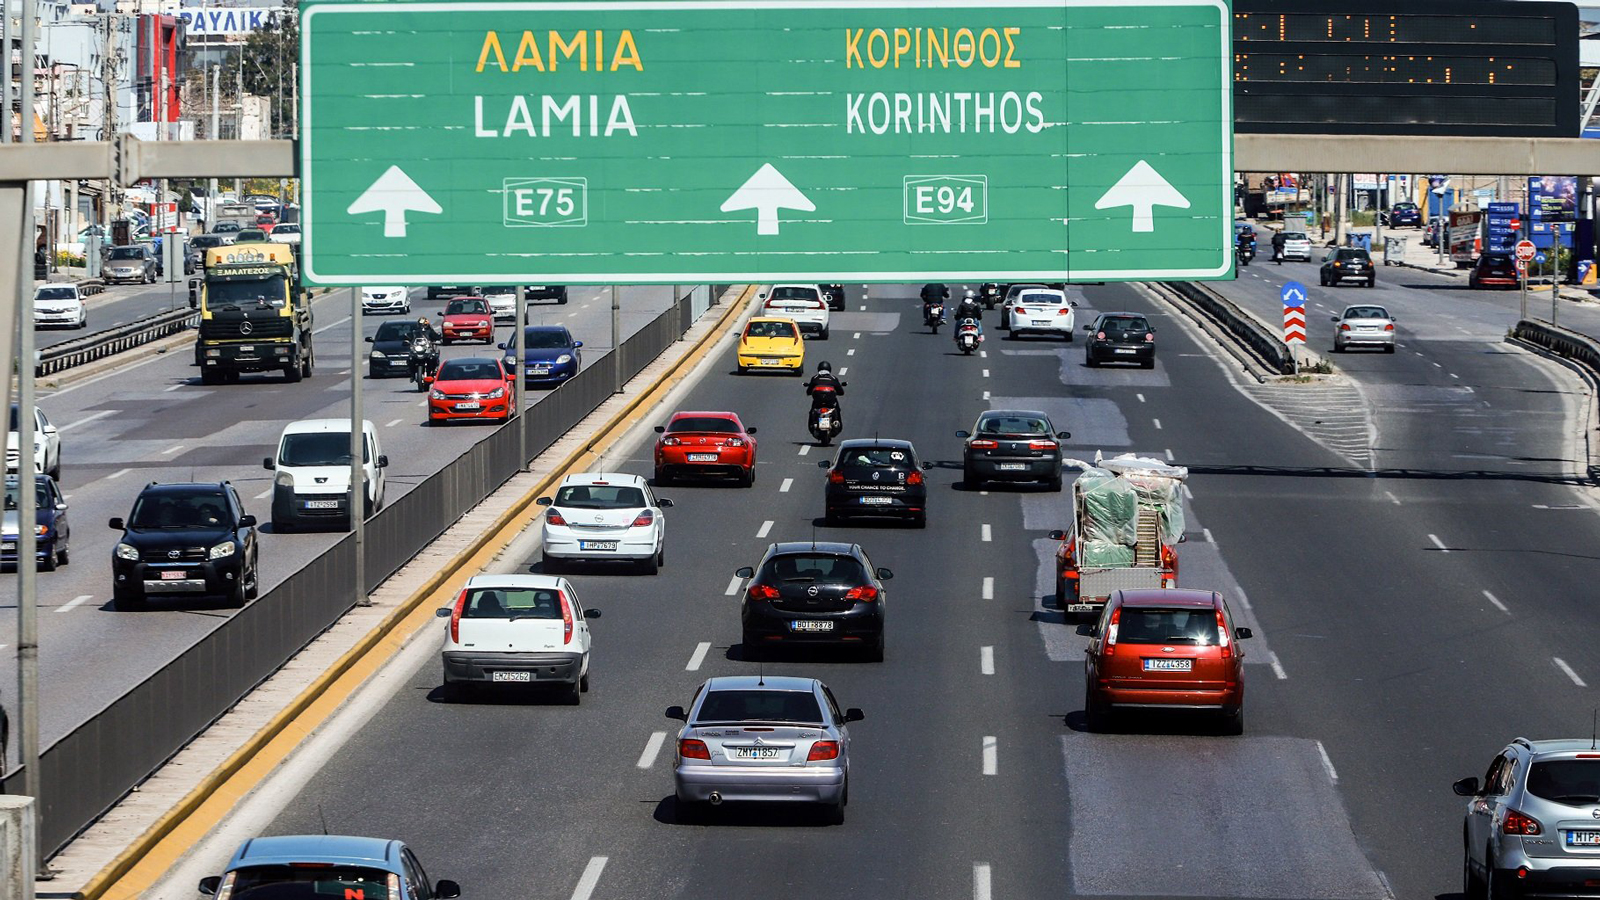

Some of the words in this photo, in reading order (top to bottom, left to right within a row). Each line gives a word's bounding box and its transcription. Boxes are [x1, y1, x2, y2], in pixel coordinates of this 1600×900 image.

[476, 30, 644, 72] ΛΑΜΙΑ
[846, 27, 1021, 69] ΚΟΡΙΝΘΟΣ
[475, 94, 638, 137] LAMIA
[847, 91, 1045, 135] KORINTHOS
[516, 188, 574, 216] E75
[916, 186, 974, 213] E94
[1517, 246, 1535, 255] STOP
